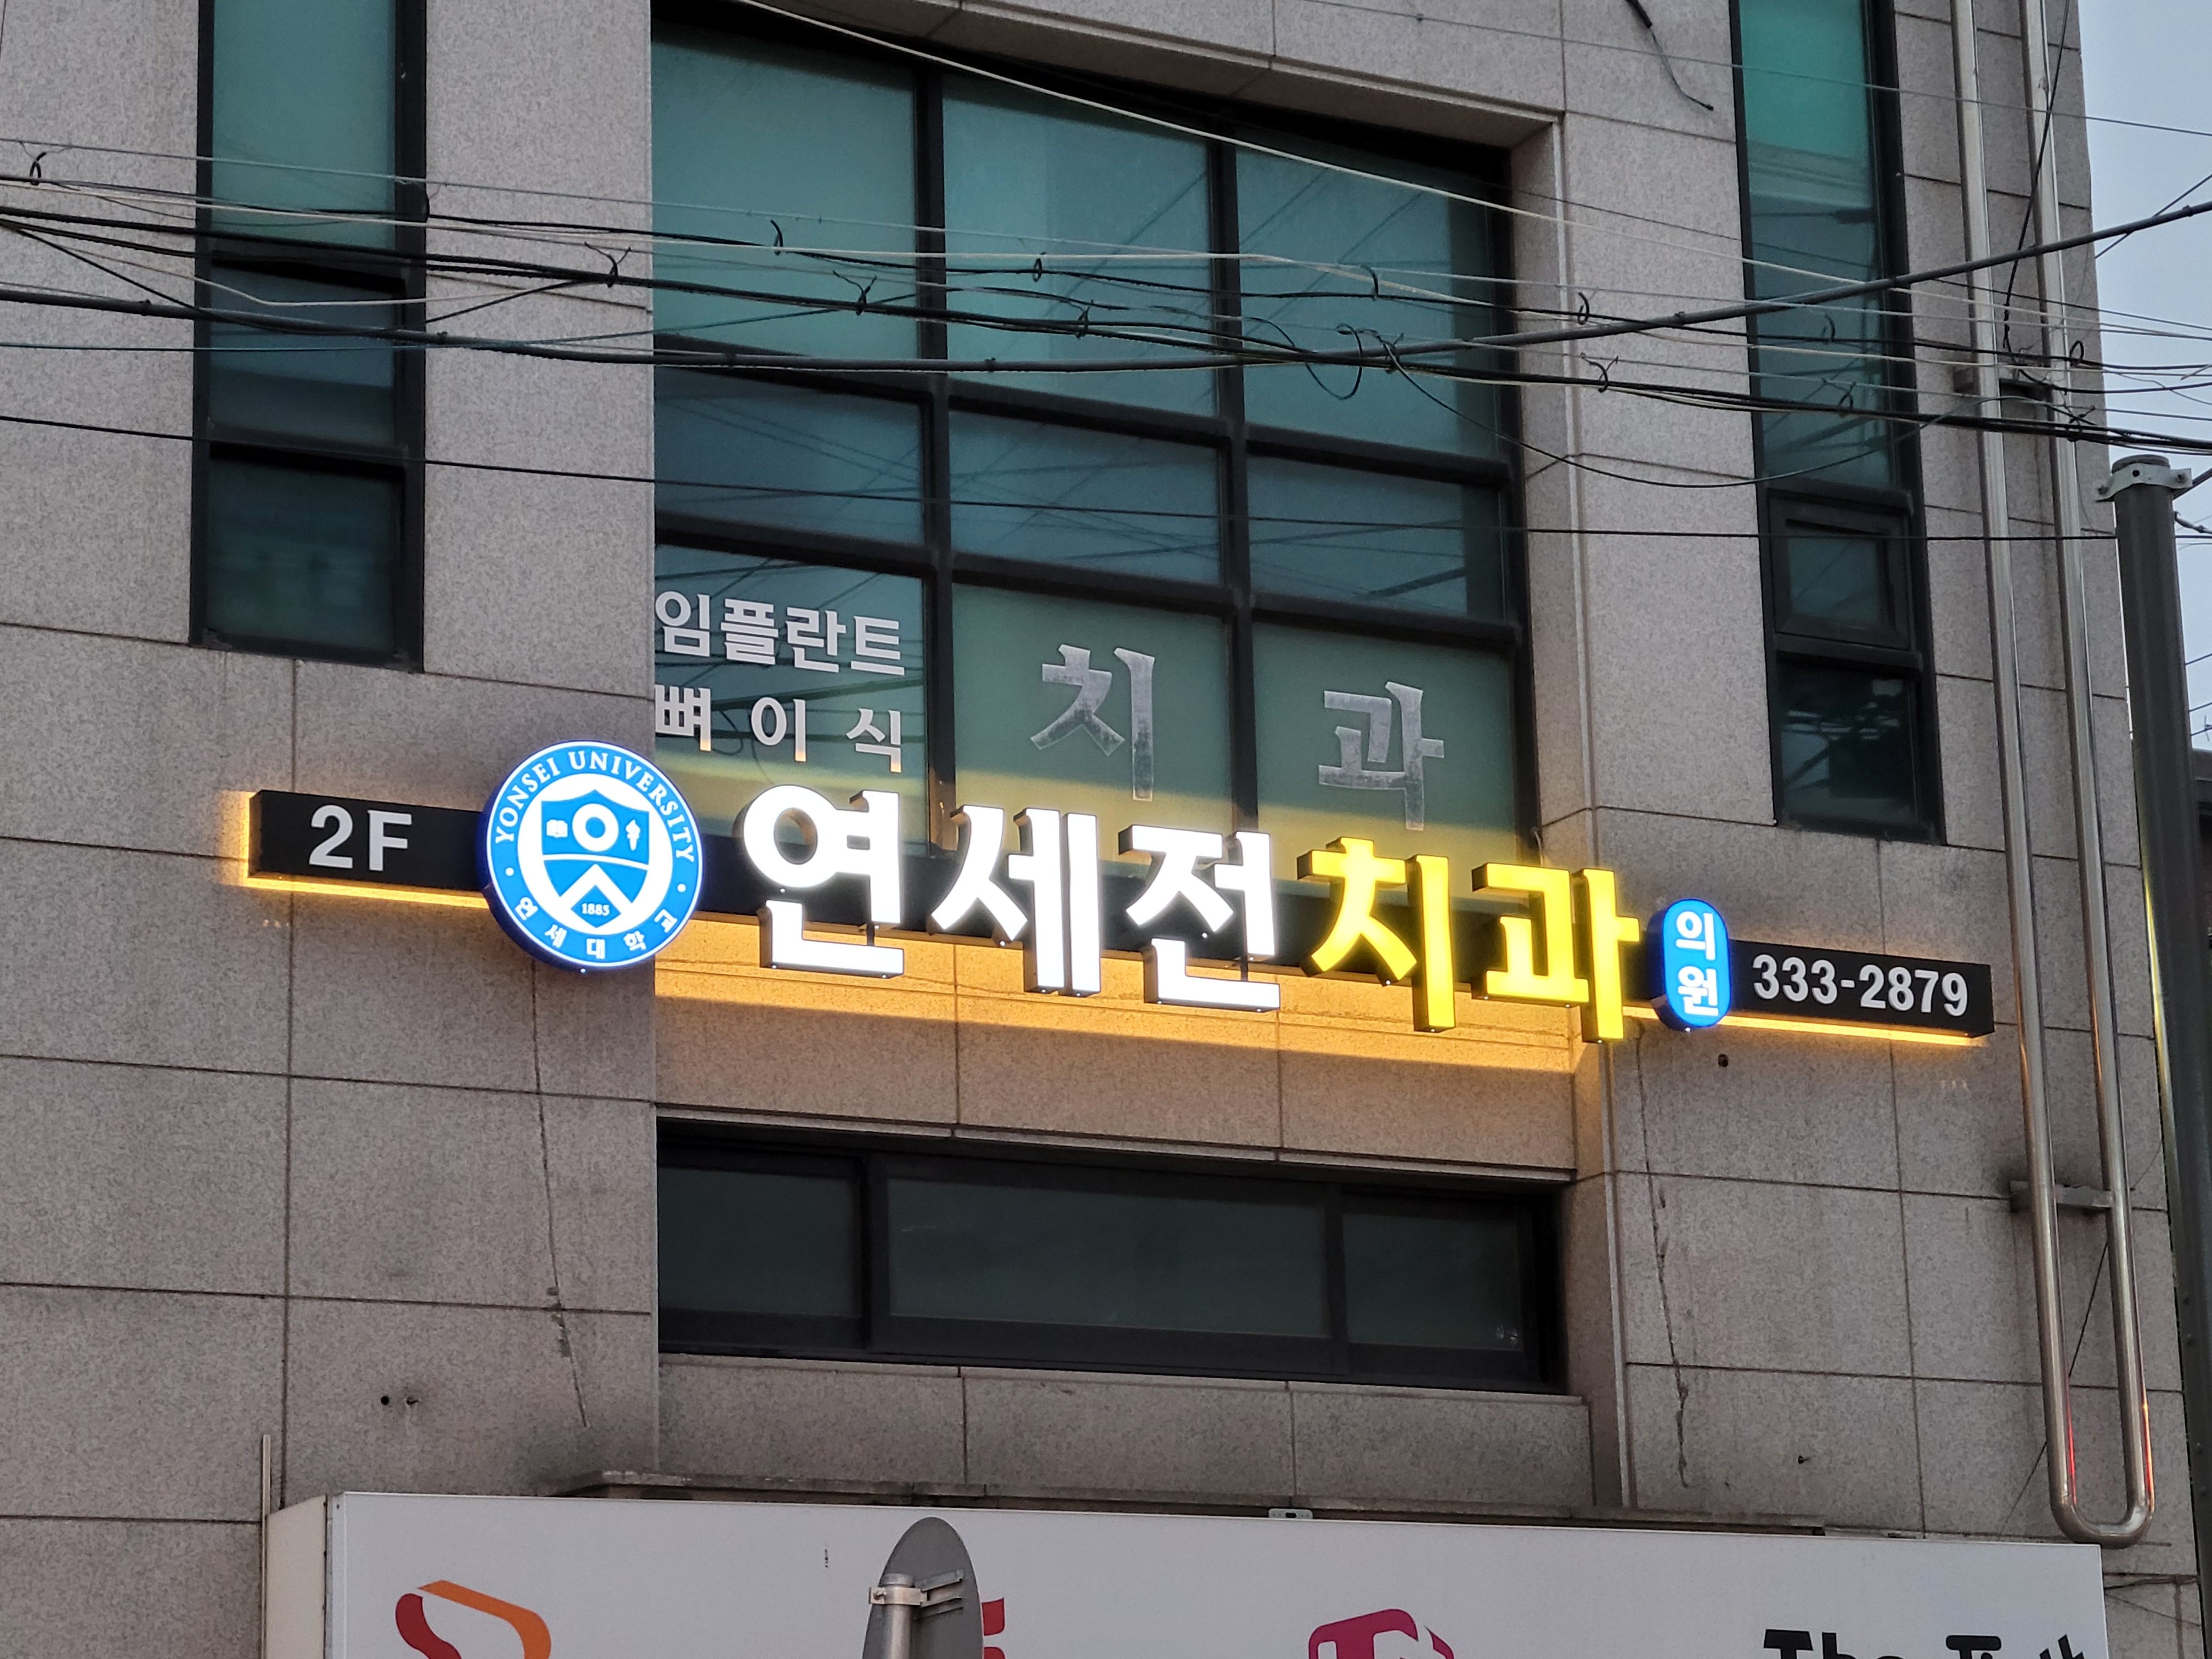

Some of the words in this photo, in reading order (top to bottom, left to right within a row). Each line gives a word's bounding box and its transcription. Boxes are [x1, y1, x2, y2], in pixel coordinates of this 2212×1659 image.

[655, 590, 905, 675] 임플란트
[308, 805, 413, 872] 2F
[495, 757, 561, 844] YONSEI
[568, 751, 695, 862] UNIVERSITY
[581, 902, 610, 917] 1885
[1675, 910, 1719, 1017] 의원
[1752, 953, 1968, 1017] 333-2879
